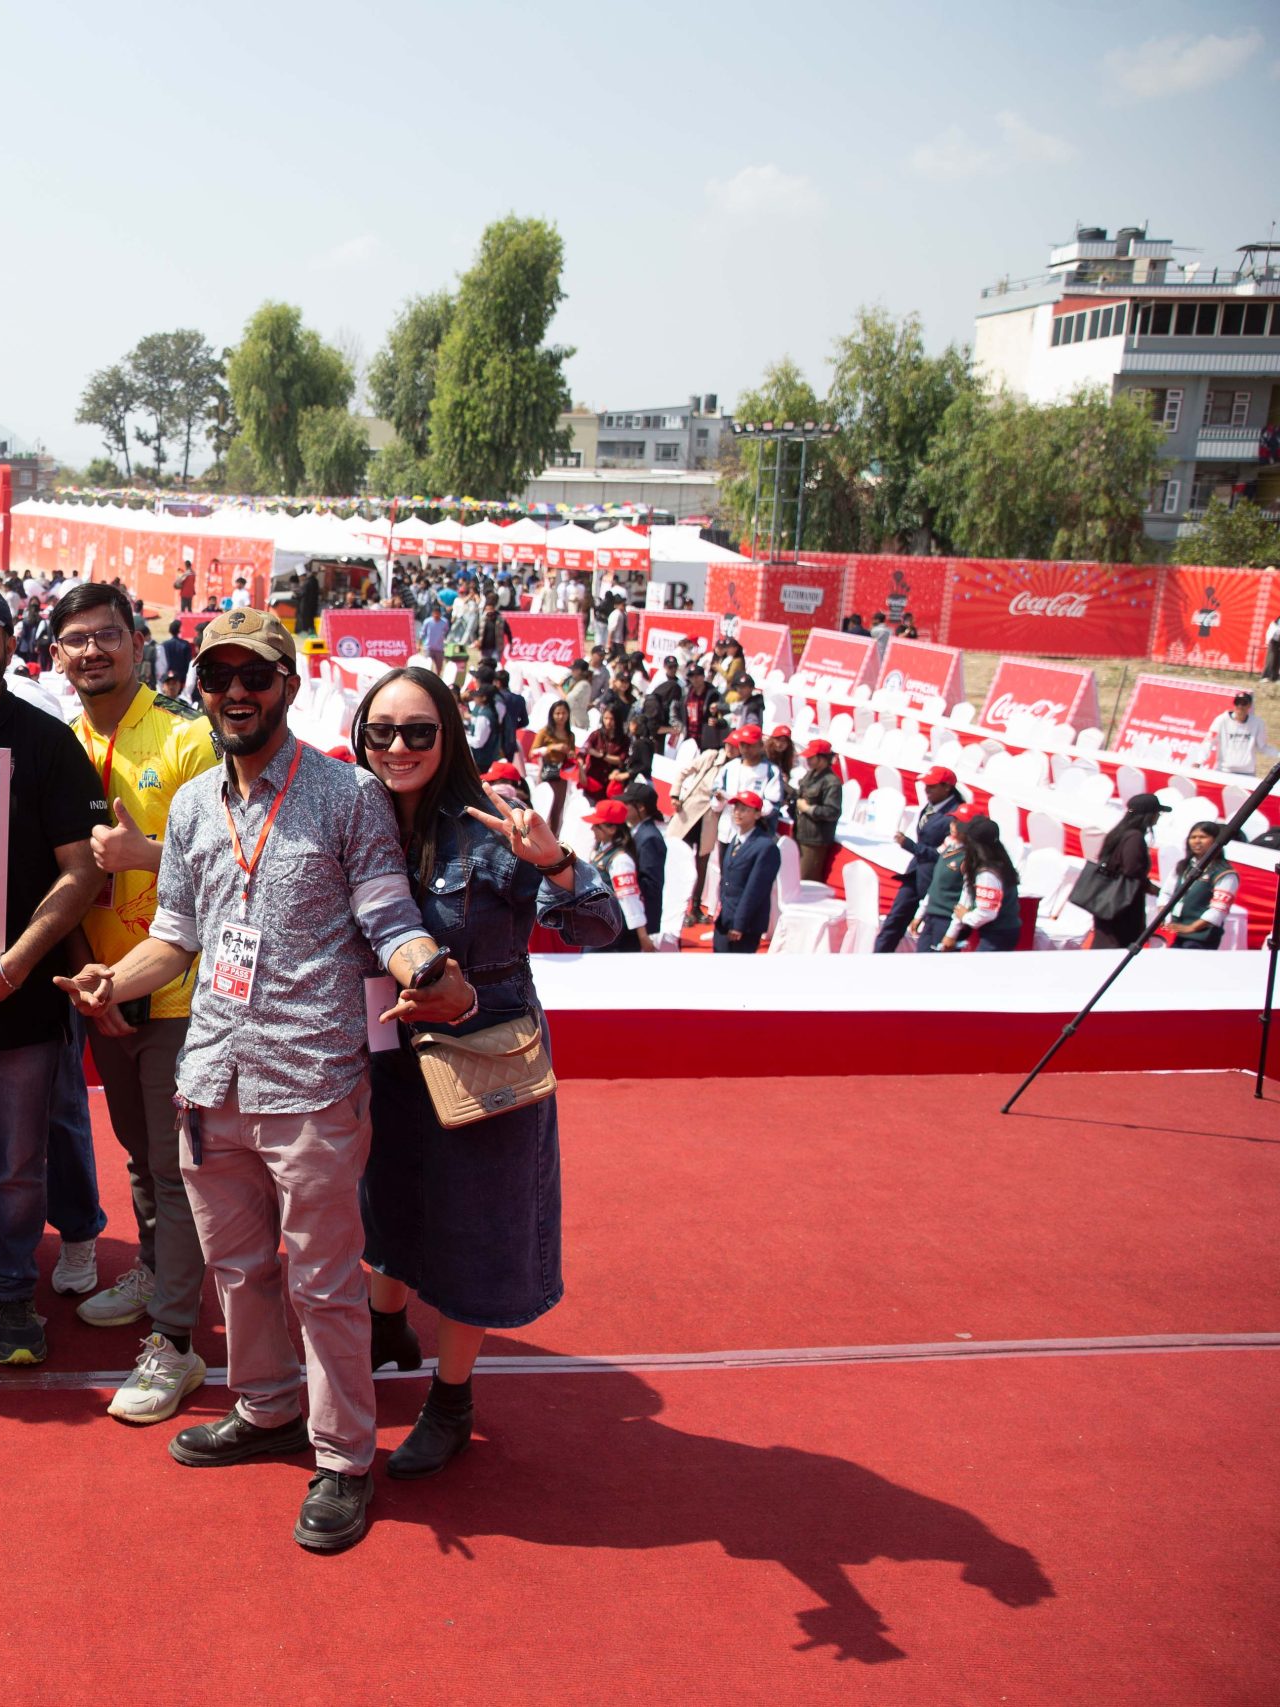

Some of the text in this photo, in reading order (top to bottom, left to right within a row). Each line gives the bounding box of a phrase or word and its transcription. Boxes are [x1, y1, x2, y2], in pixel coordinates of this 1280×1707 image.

[783, 590, 819, 600] KATHMANDU
[1008, 590, 1093, 618] Coca-Cola
[365, 640, 408, 649] OFFICIAL
[367, 649, 408, 657] ATTEMPT
[138, 779, 162, 790] KINGS
[219, 964, 249, 979] VIP PASS
